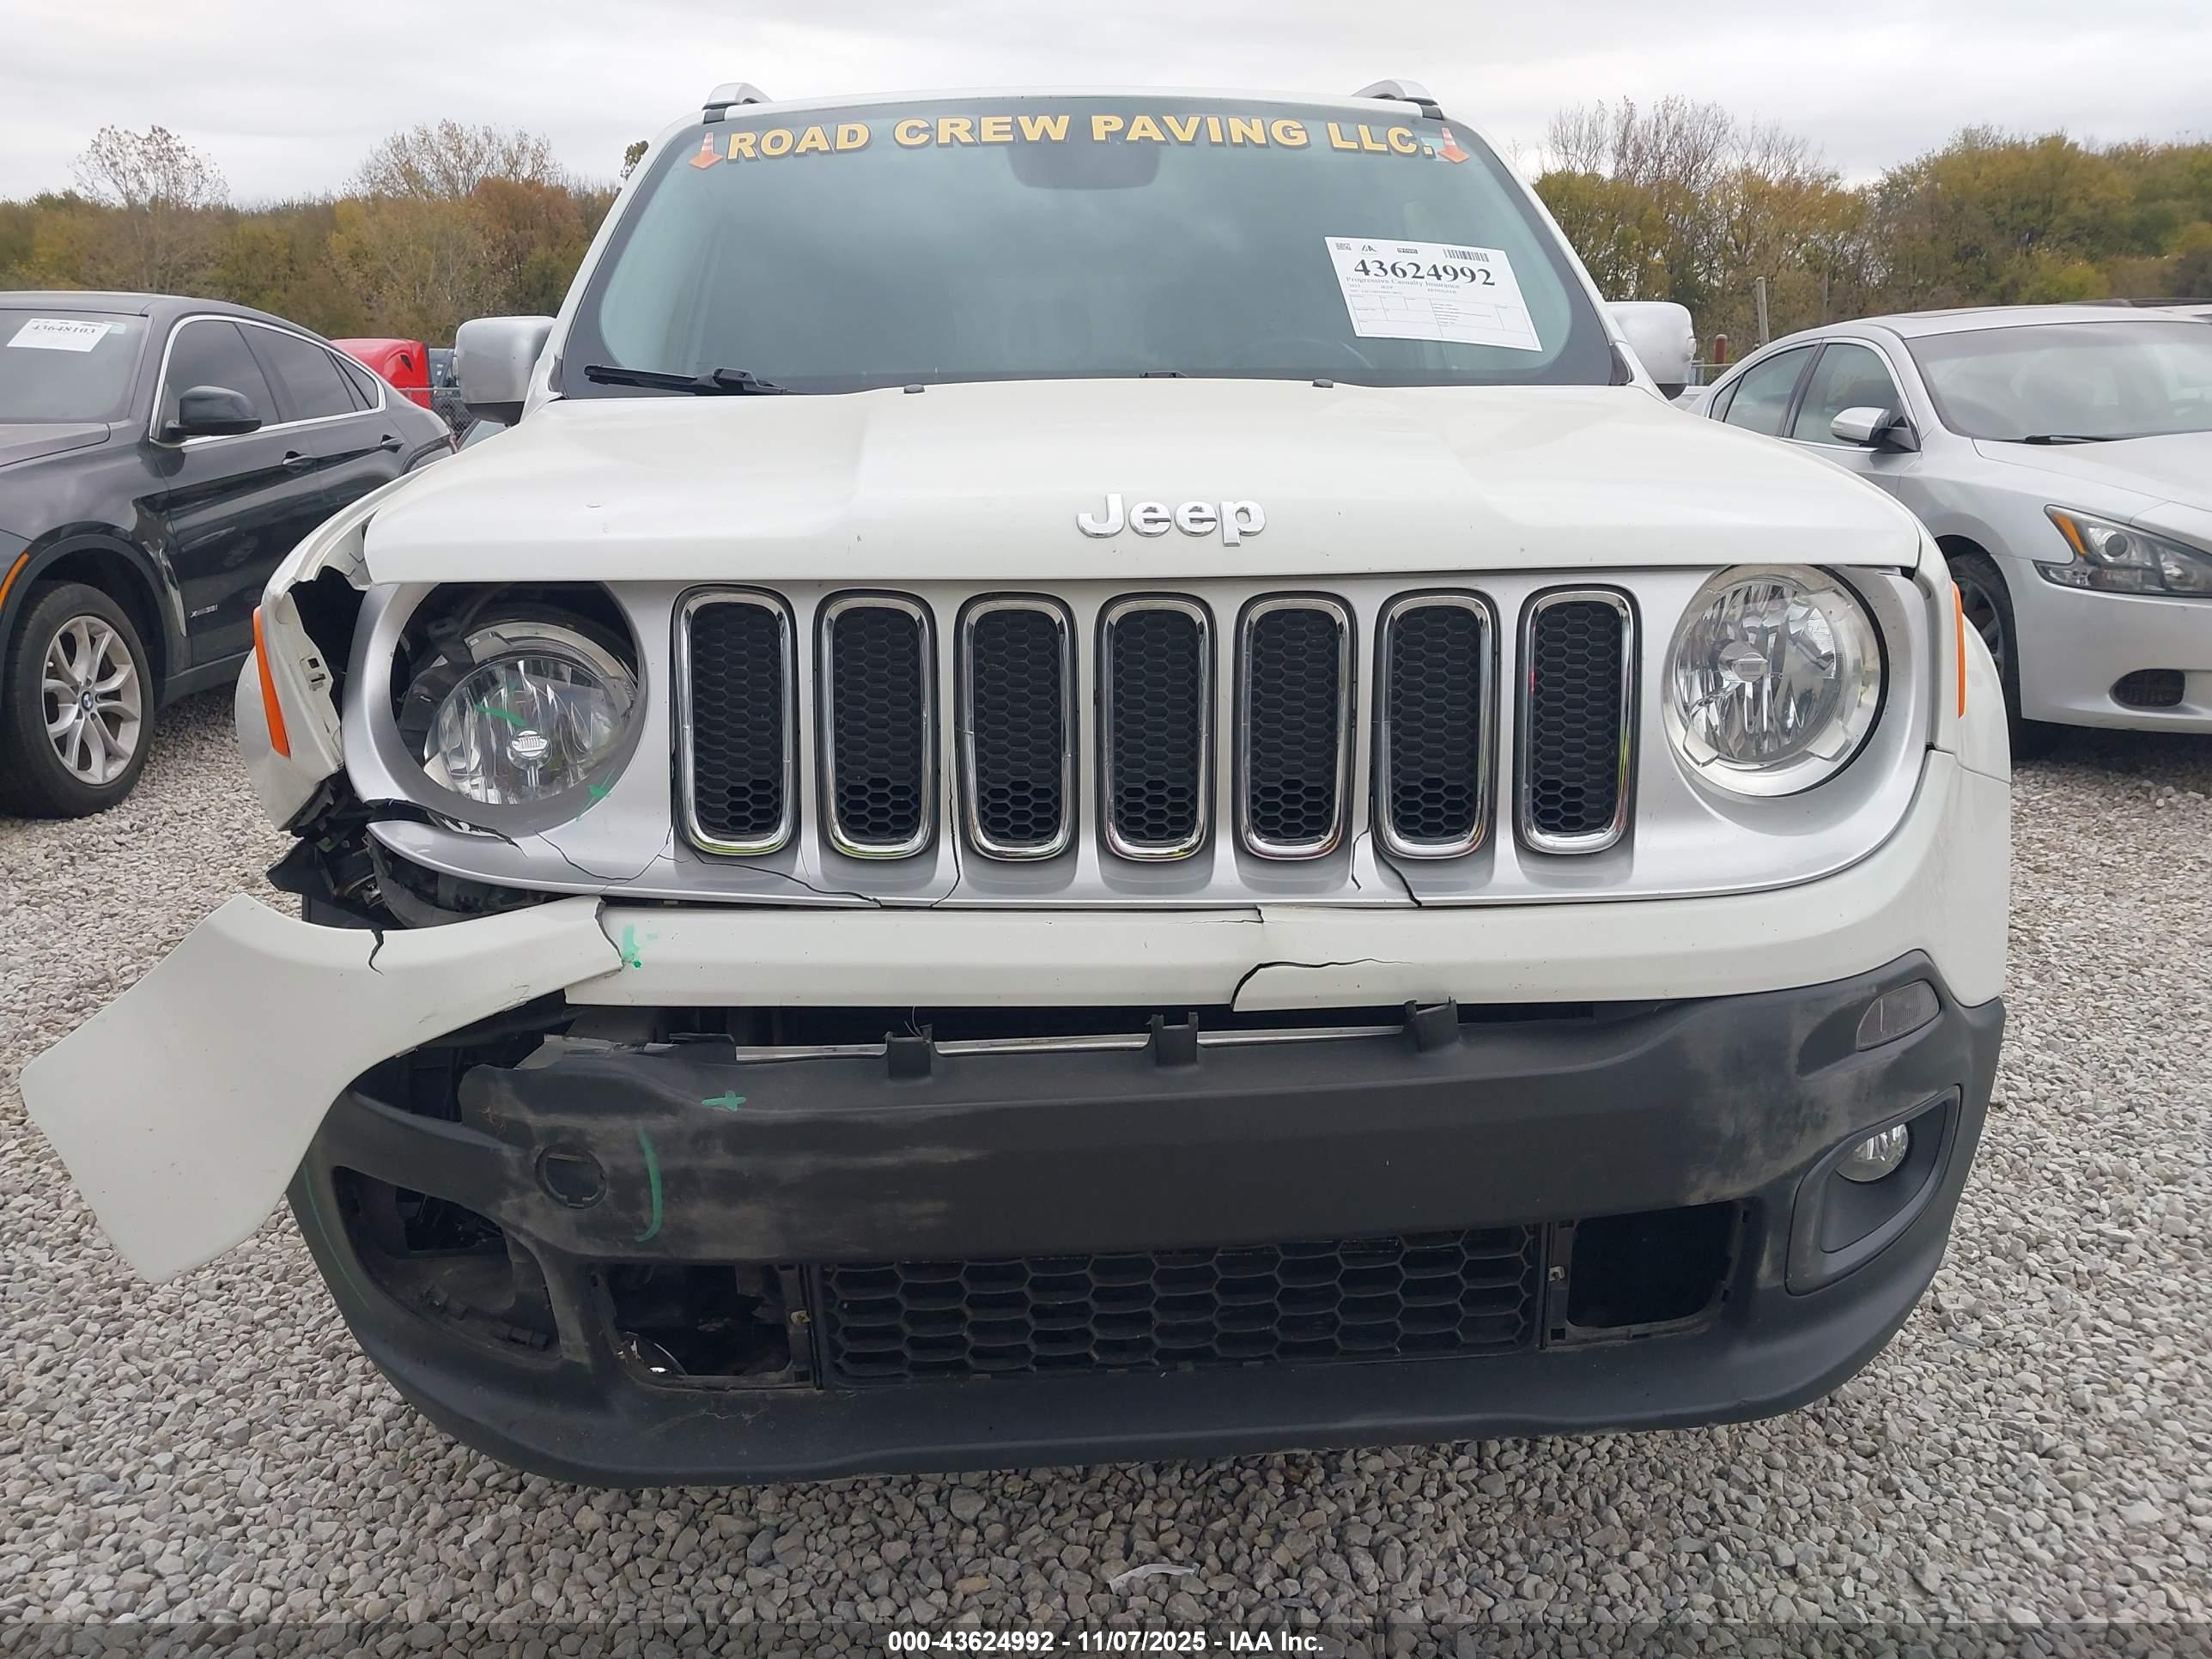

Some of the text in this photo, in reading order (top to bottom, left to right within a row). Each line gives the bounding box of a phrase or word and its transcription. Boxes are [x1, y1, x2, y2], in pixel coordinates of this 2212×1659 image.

[726, 114, 1437, 164] ROAD CREW PAVING LLC.
[1354, 258, 1496, 287] 43624992
[1425, 281, 1461, 289] Insurance
[1076, 493, 1267, 547] Jeep
